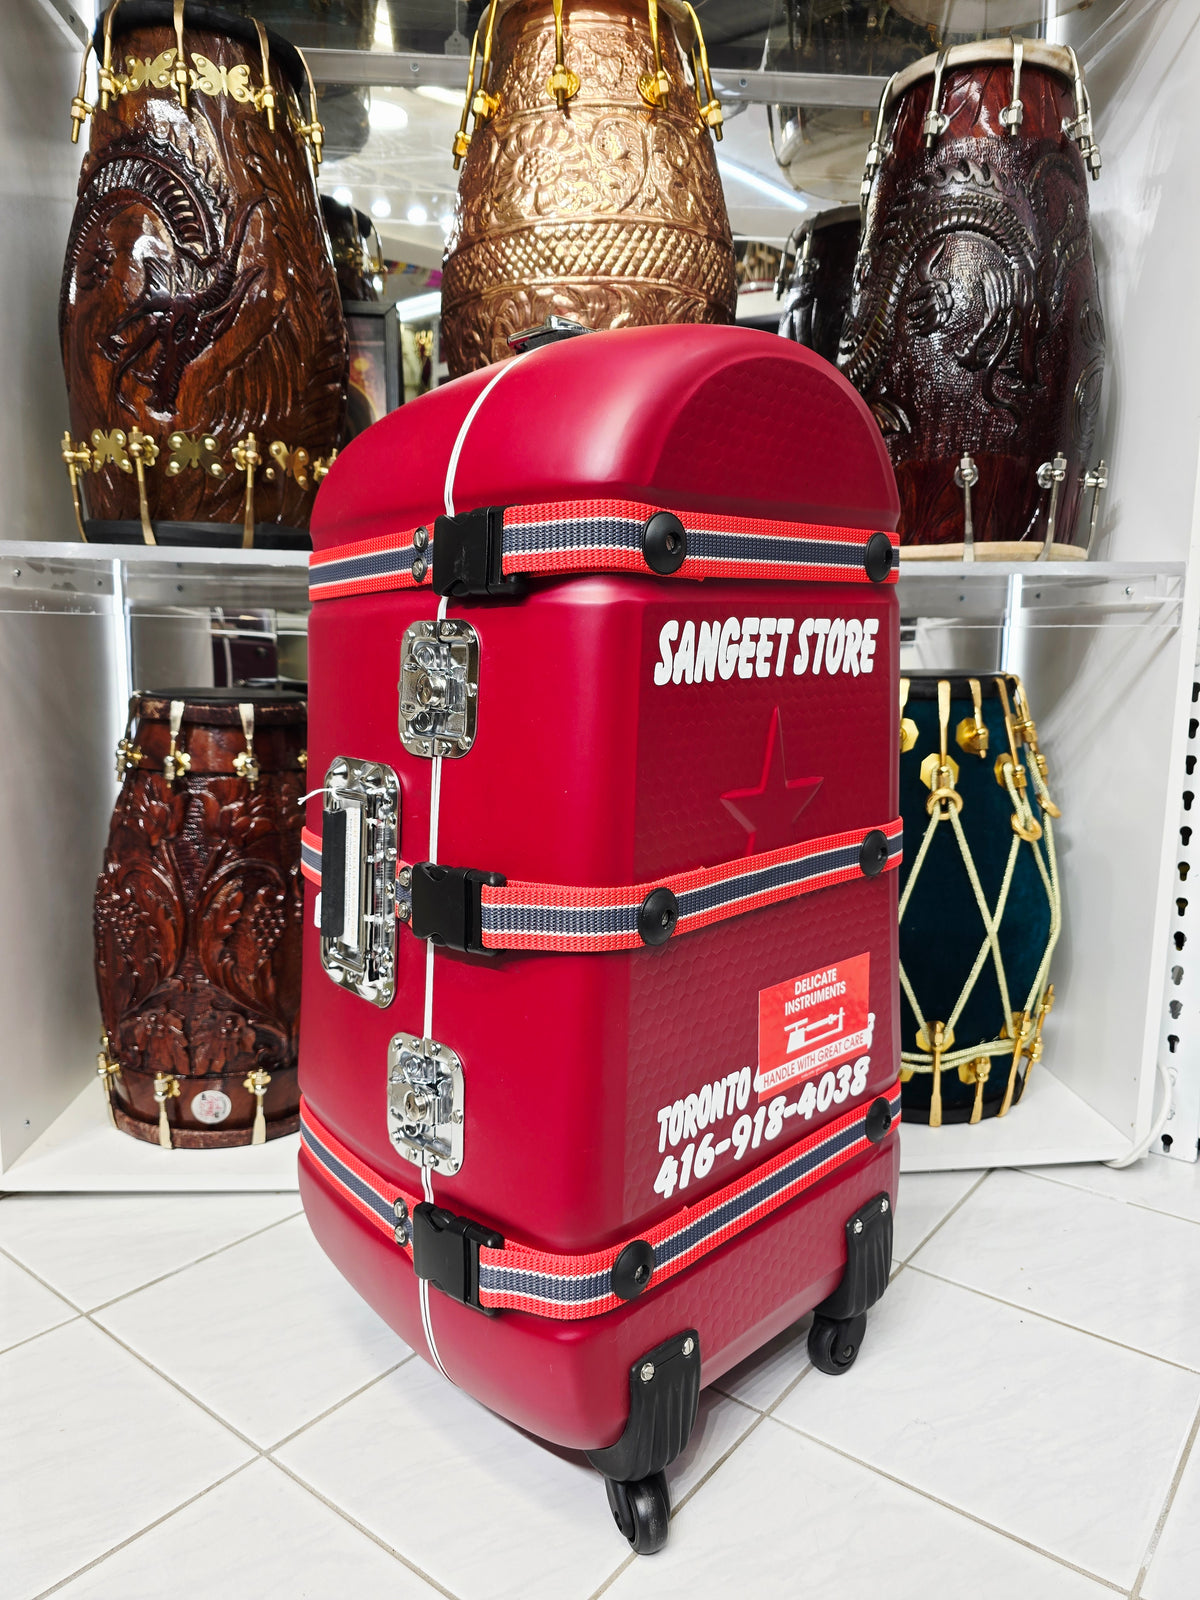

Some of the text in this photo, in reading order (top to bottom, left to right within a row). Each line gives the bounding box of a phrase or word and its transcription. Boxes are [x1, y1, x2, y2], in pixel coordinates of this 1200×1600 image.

[653, 616, 880, 686] SANGEET STORE
[785, 981, 846, 1016] INSTRUMENTS
[795, 968, 837, 994] DELICATE
[763, 1063, 795, 1088] HANDLE
[797, 1053, 815, 1070] WITH
[818, 1043, 842, 1062] GREAT
[844, 1033, 864, 1050] CARE
[653, 1056, 871, 1199] 416-918-4038
[657, 1066, 752, 1153] TORONTO
